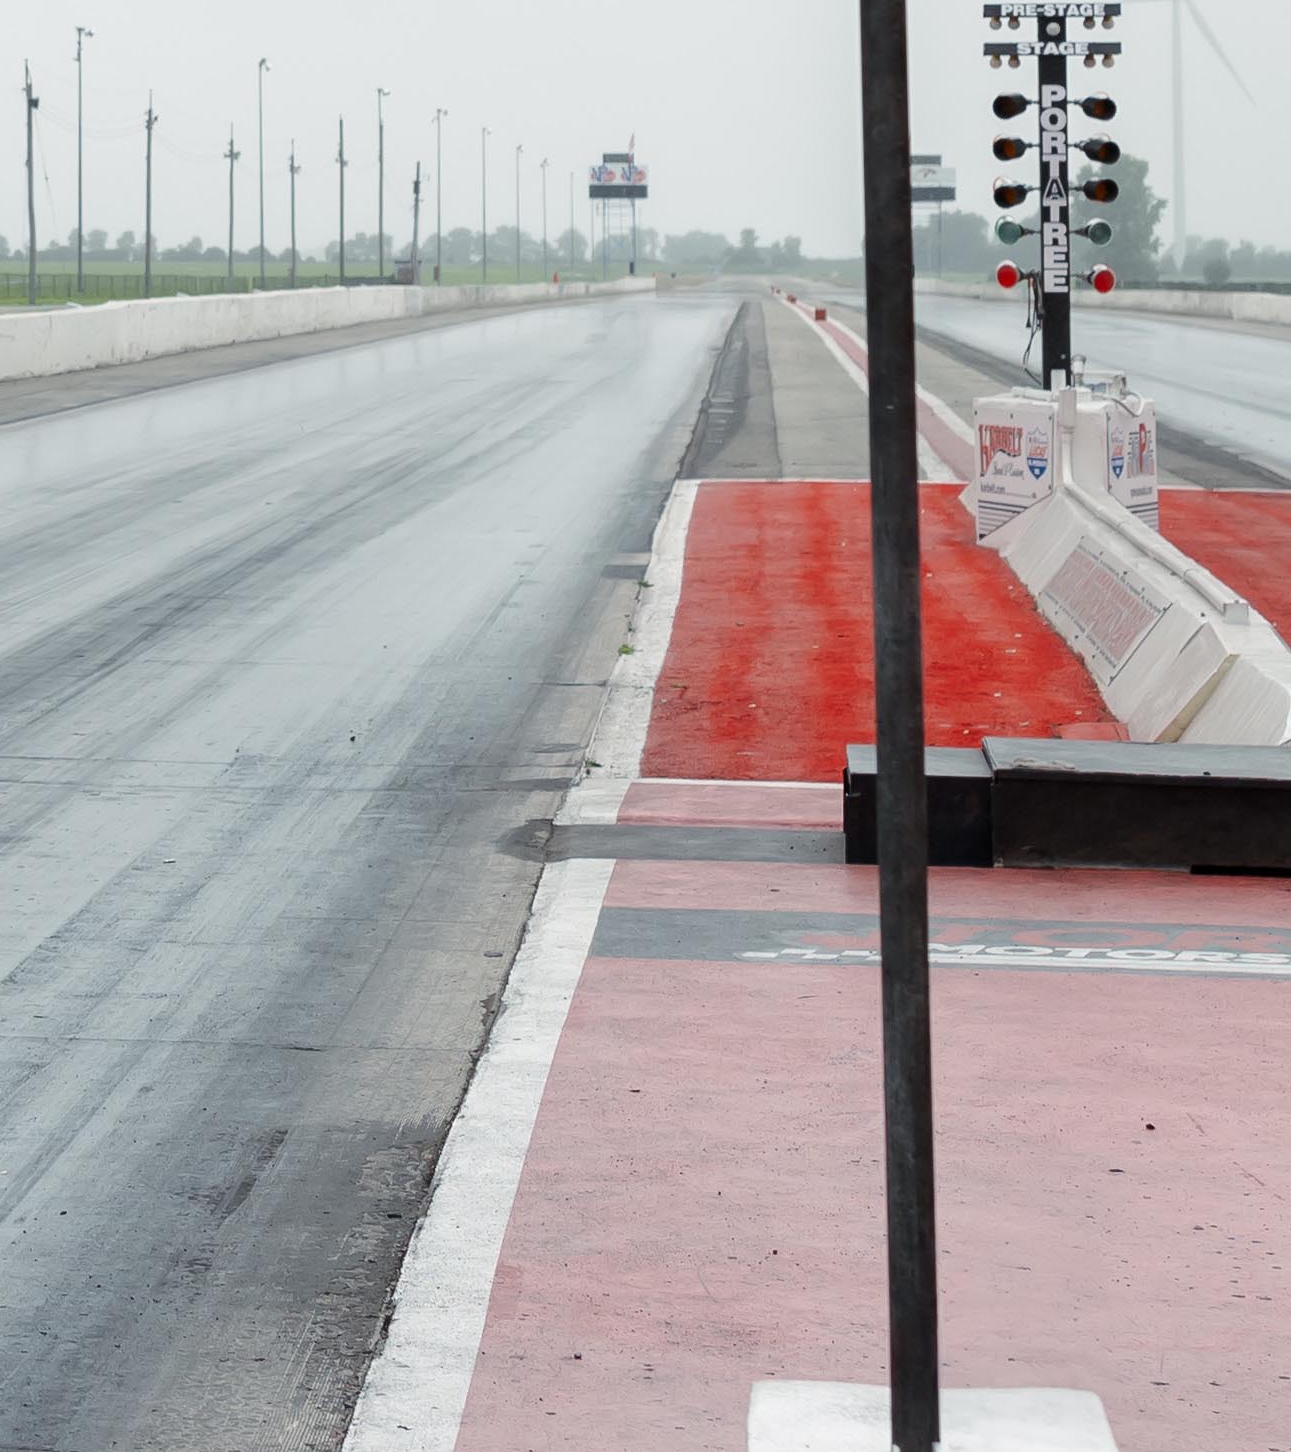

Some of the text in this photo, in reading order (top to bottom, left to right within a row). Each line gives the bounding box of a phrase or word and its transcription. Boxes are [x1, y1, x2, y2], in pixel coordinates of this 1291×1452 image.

[1001, 3, 1105, 17] PRE-STAGE
[1017, 42, 1089, 56] STAGE
[1040, 84, 1069, 293] PORTATREE
